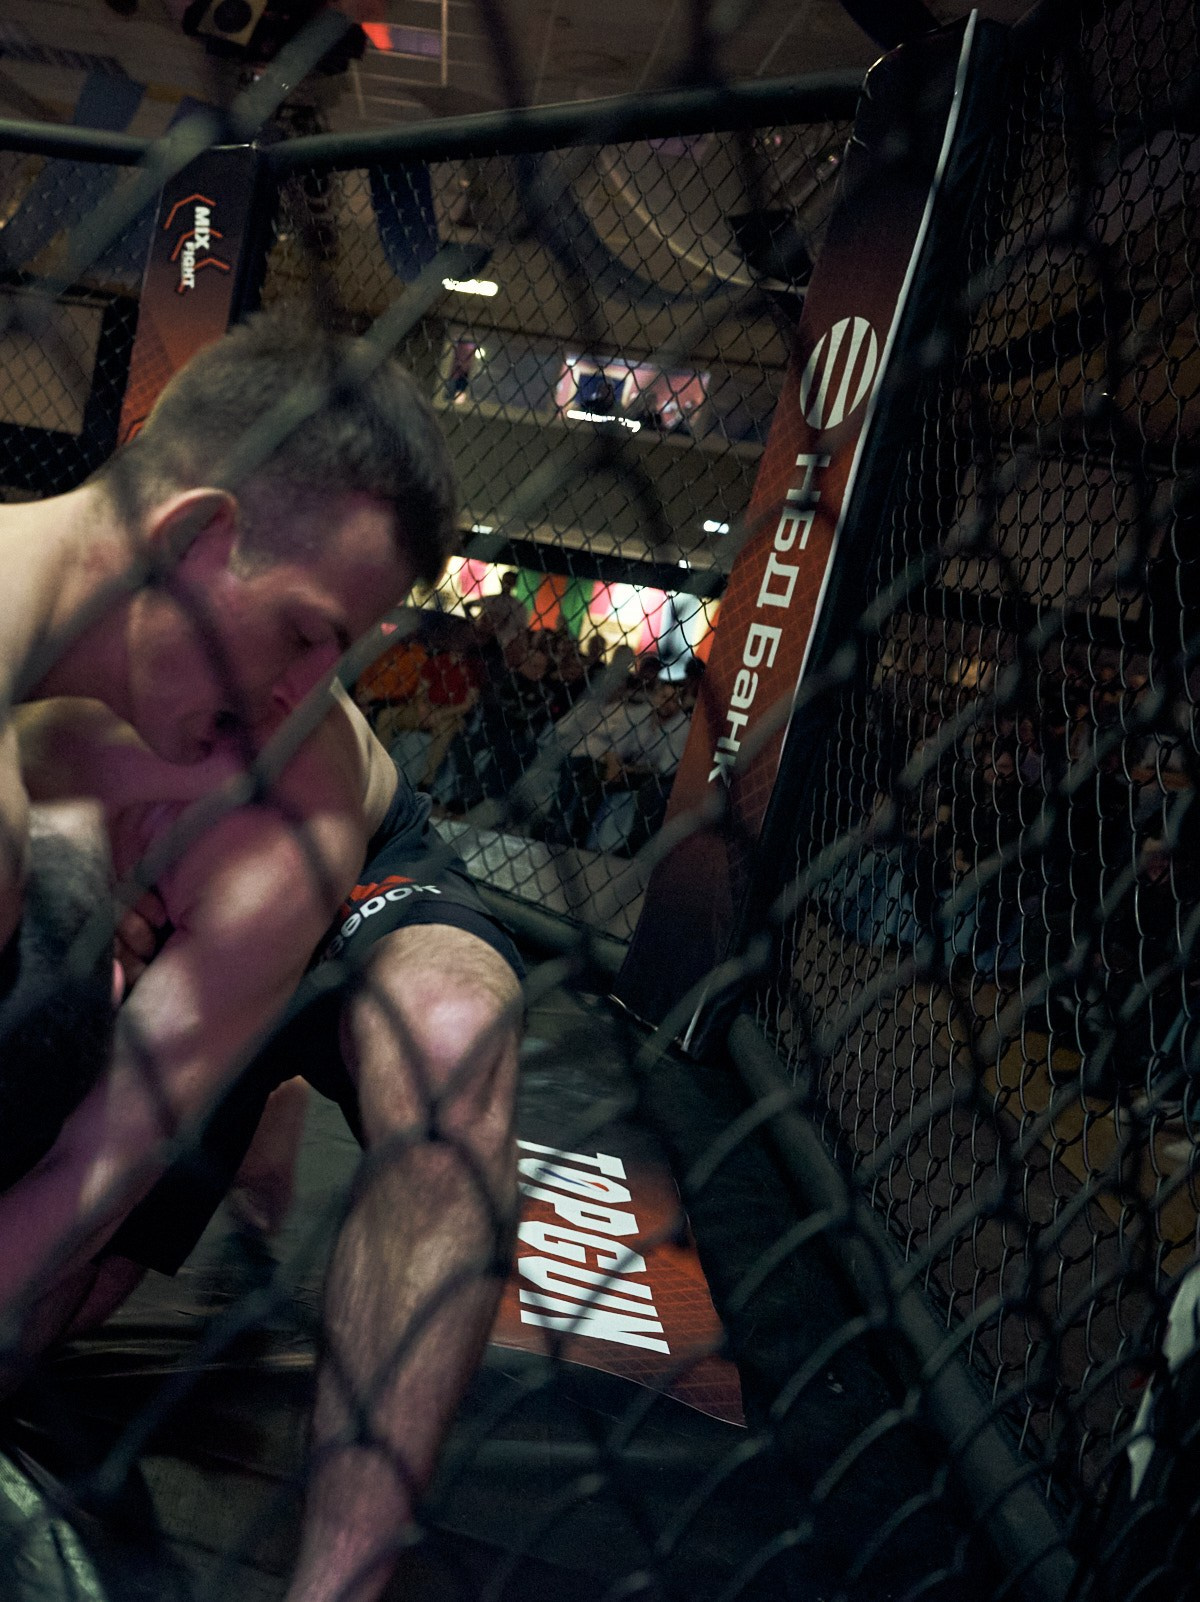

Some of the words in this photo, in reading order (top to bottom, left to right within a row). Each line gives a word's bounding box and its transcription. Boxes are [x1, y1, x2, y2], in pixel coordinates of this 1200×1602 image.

[181, 241, 195, 289] FIGHT
[194, 206, 210, 250] MIX
[757, 453, 830, 609] НБД
[707, 622, 782, 788] Банк
[515, 1138, 670, 1355] TOPGUN
